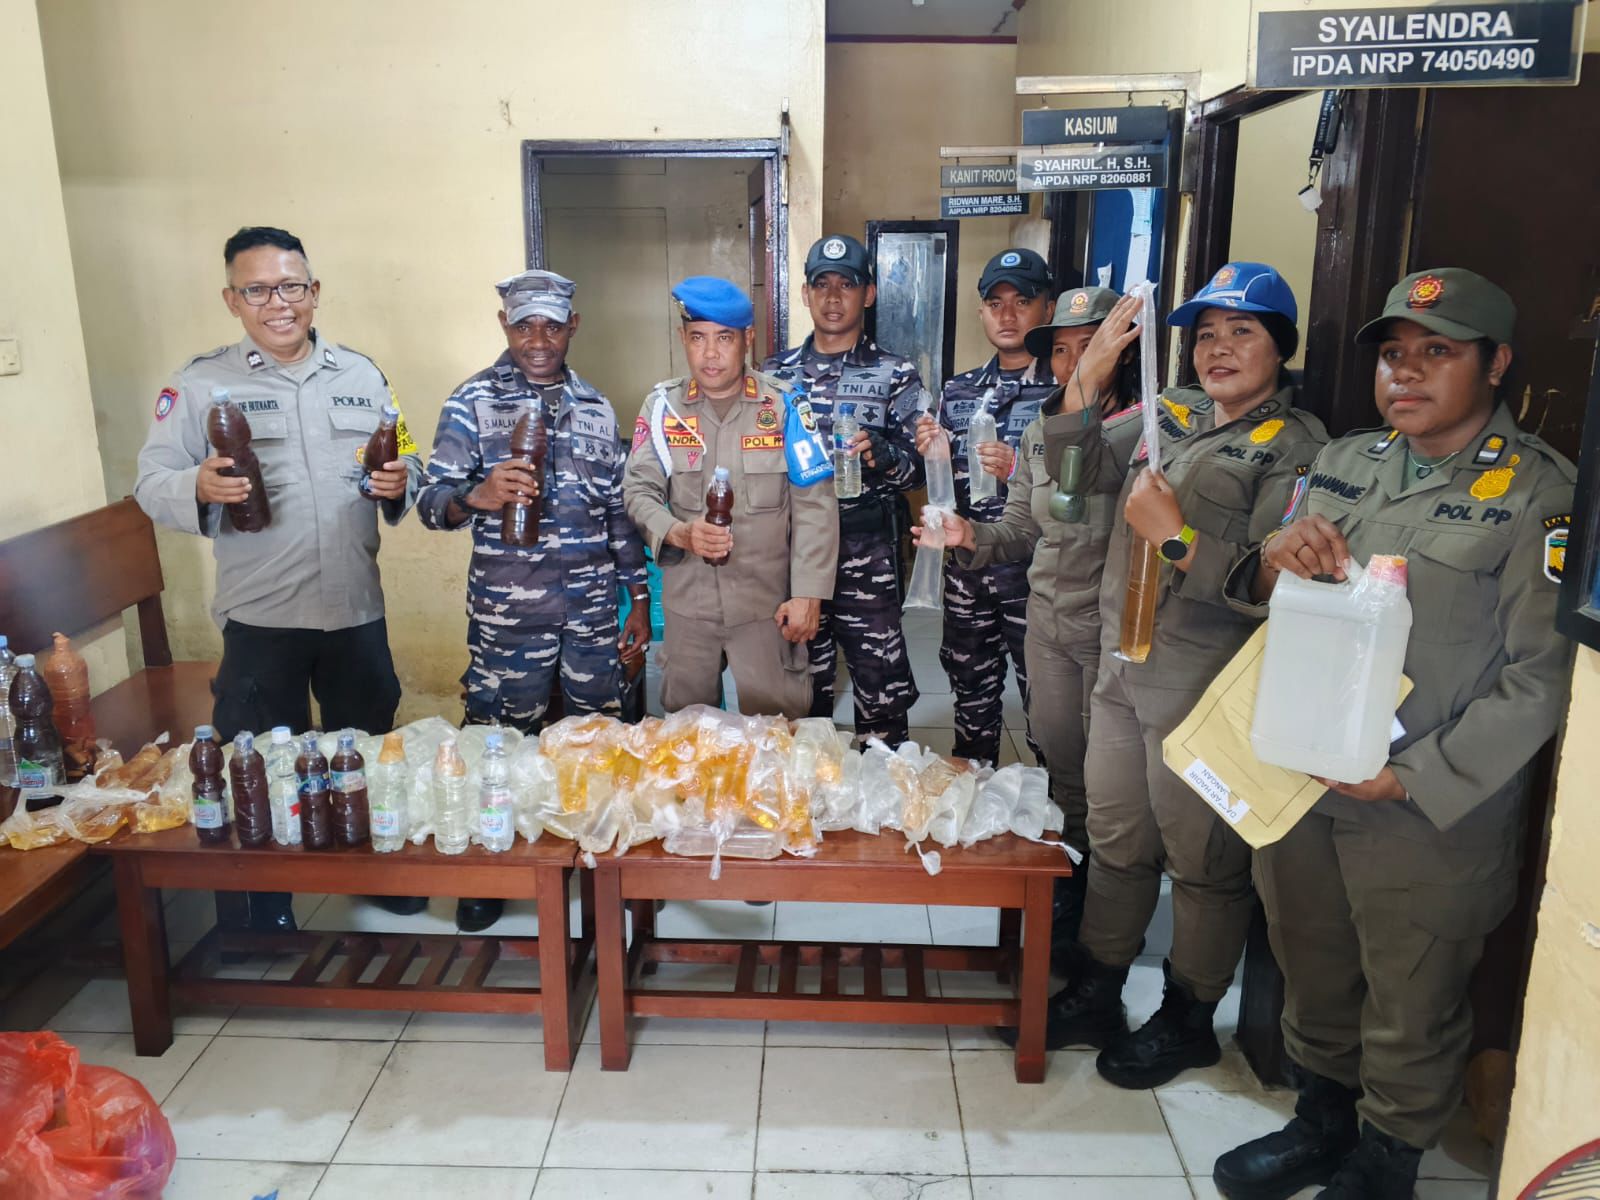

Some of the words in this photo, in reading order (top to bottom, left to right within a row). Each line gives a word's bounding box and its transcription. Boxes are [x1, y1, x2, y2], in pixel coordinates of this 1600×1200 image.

[1318, 10, 1514, 43] SYAILENDRA
[1292, 53, 1354, 77] IPDA
[1360, 51, 1414, 75] NRP
[1422, 47, 1536, 73] 74050490
[1064, 115, 1118, 136] KASIUM
[1034, 158, 1103, 172] SYAHRUL.
[1124, 156, 1151, 169] S.H.
[950, 169, 981, 183] KANIT
[1034, 174, 1071, 187] AIPDA
[1073, 174, 1098, 186] NRP
[1100, 172, 1152, 184] 82060881
[948, 196, 980, 207] RIDWAN
[948, 206, 972, 215] AIPDA
[973, 205, 989, 214] NRP
[842, 384, 863, 393] TNI
[867, 385, 884, 395] AL
[331, 396, 373, 408] POLRI
[578, 420, 595, 432] TNI
[599, 424, 612, 437] AL
[744, 437, 770, 447] POL
[1217, 445, 1248, 460] POL
[1250, 450, 1275, 466] PP
[1434, 503, 1473, 521] POL
[1481, 506, 1513, 525] PP
